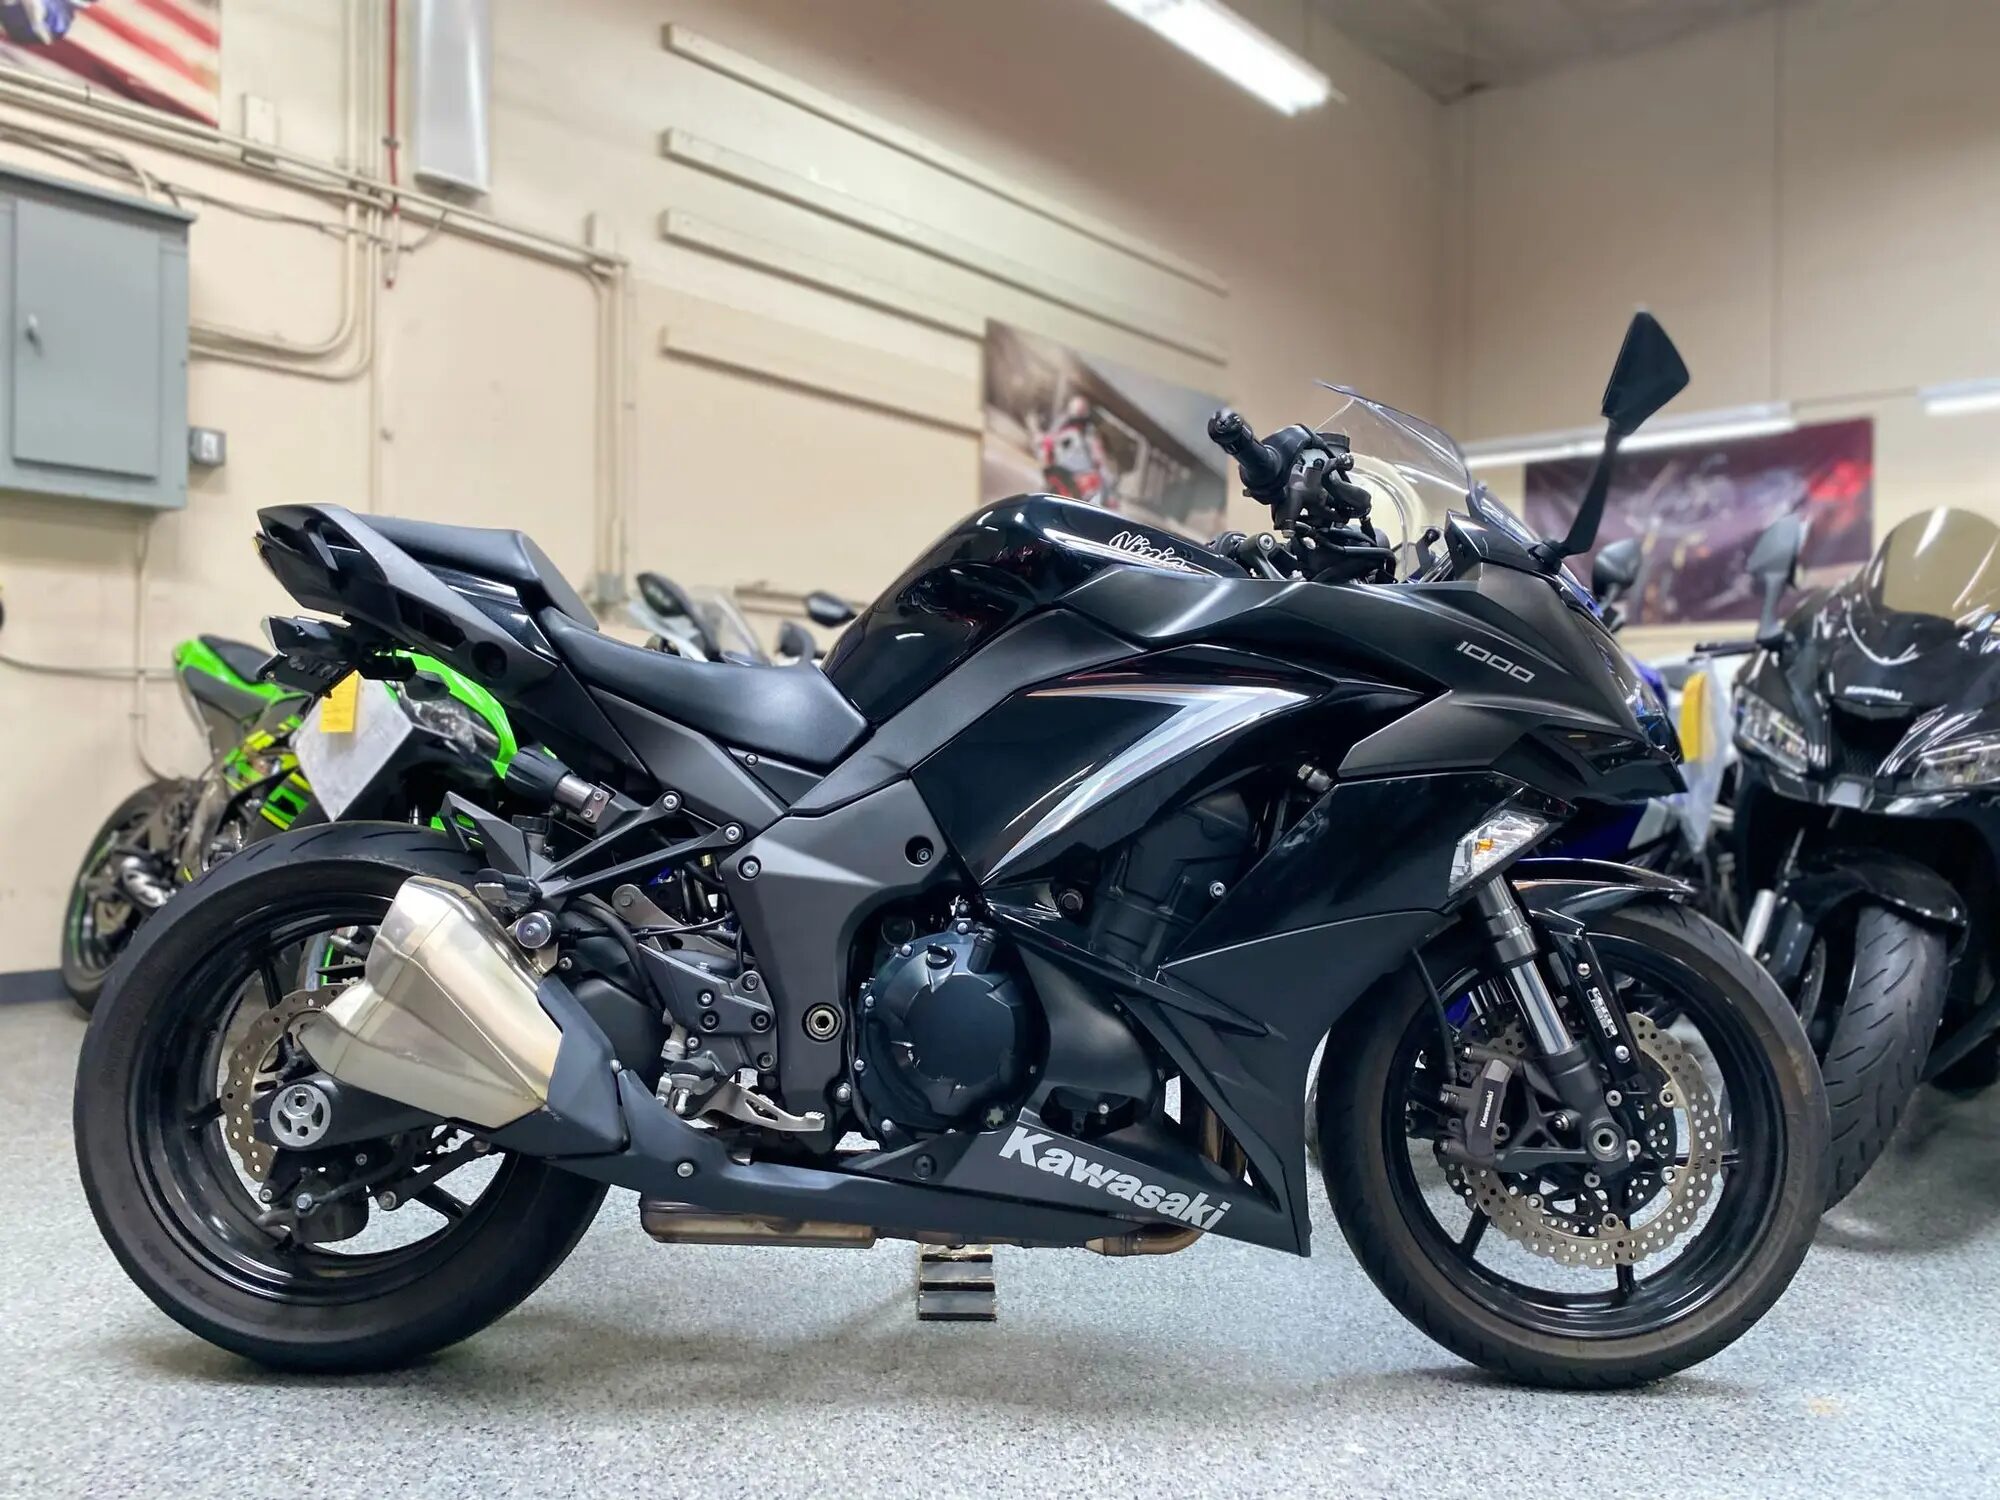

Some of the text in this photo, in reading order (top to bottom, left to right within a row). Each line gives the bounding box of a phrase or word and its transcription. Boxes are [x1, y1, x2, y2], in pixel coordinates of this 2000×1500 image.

[1108, 531, 1186, 569] Ninja
[1456, 640, 1536, 683] 1000
[1480, 1090, 1494, 1128] Kawasaki
[998, 1125, 1232, 1231] Kawasaki
